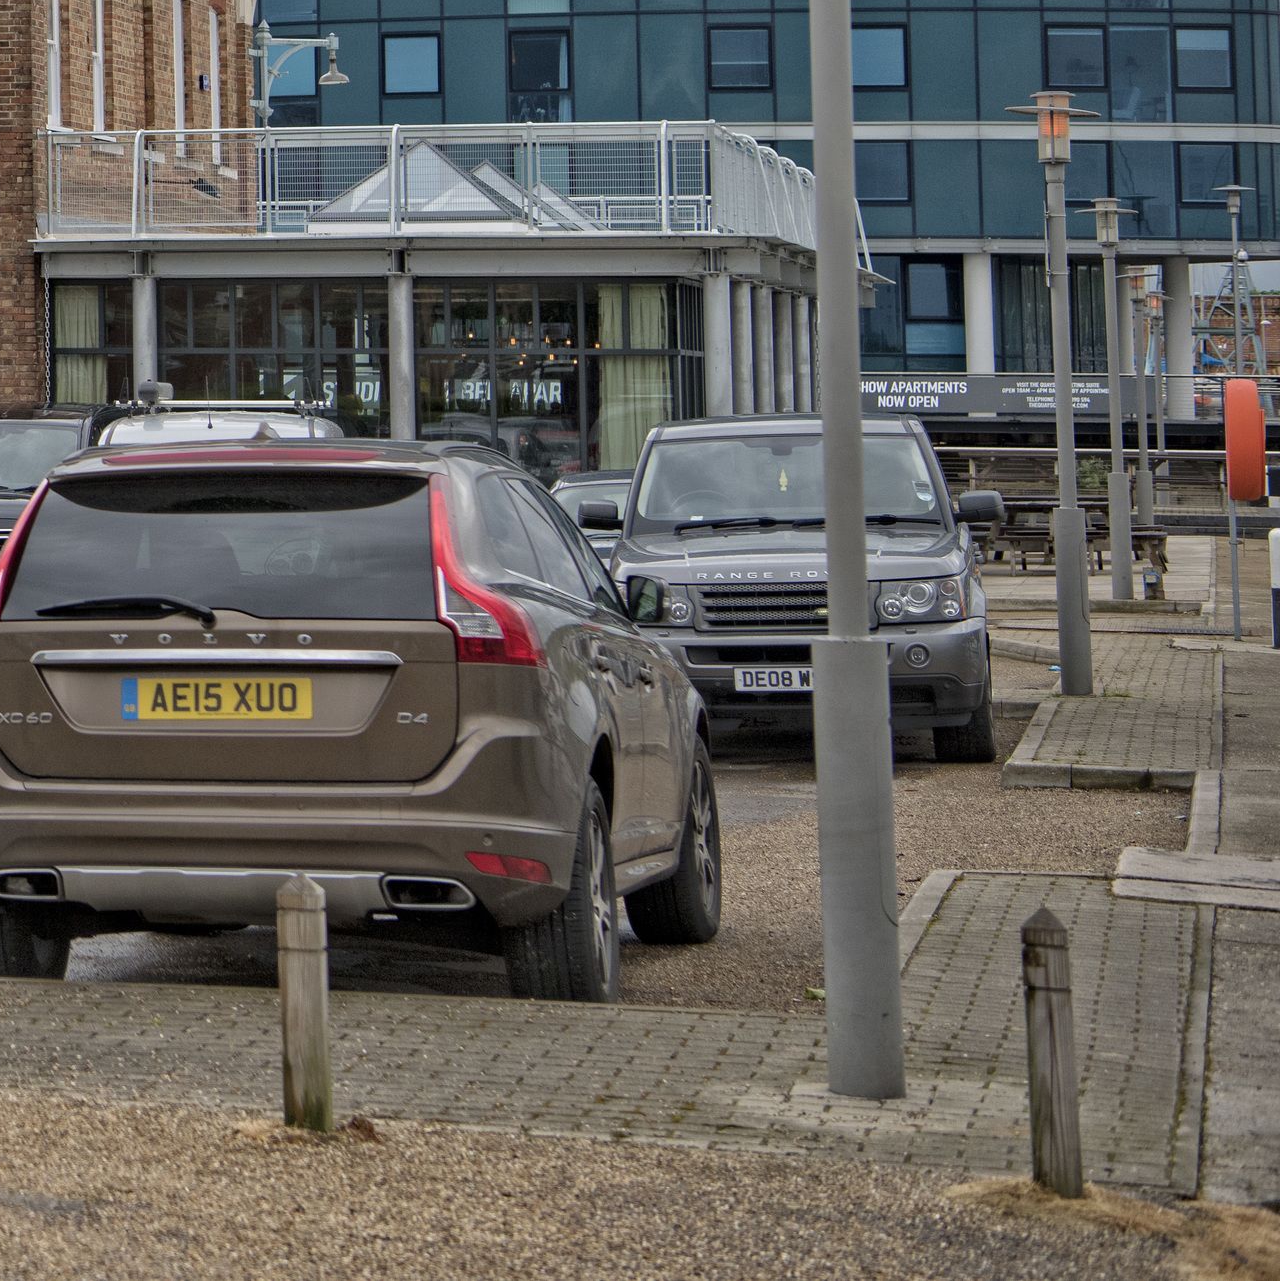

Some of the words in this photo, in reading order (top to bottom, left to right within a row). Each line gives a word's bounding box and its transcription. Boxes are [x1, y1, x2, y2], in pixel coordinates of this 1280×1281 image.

[859, 381, 888, 394] HOW
[891, 381, 967, 394] APARTMENTS
[877, 394, 900, 408] NOW
[907, 394, 939, 408] OPEN
[696, 571, 774, 580] RANGE
[109, 633, 313, 645] VOLVO
[742, 670, 793, 688] DE08
[151, 682, 223, 712] AE15
[233, 682, 297, 712] XUO
[396, 712, 429, 725] D4
